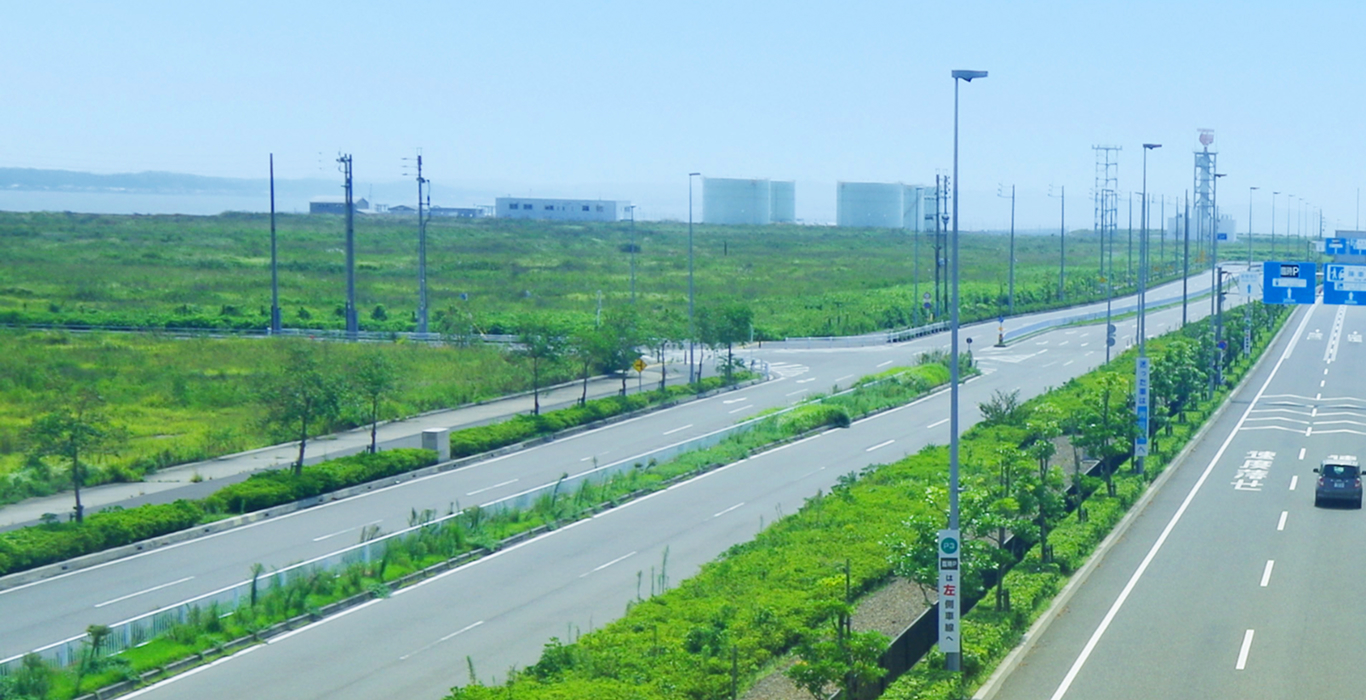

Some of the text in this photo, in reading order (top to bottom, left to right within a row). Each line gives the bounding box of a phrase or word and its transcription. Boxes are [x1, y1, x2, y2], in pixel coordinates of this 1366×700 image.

[943, 574, 956, 641] は左側車線へ
